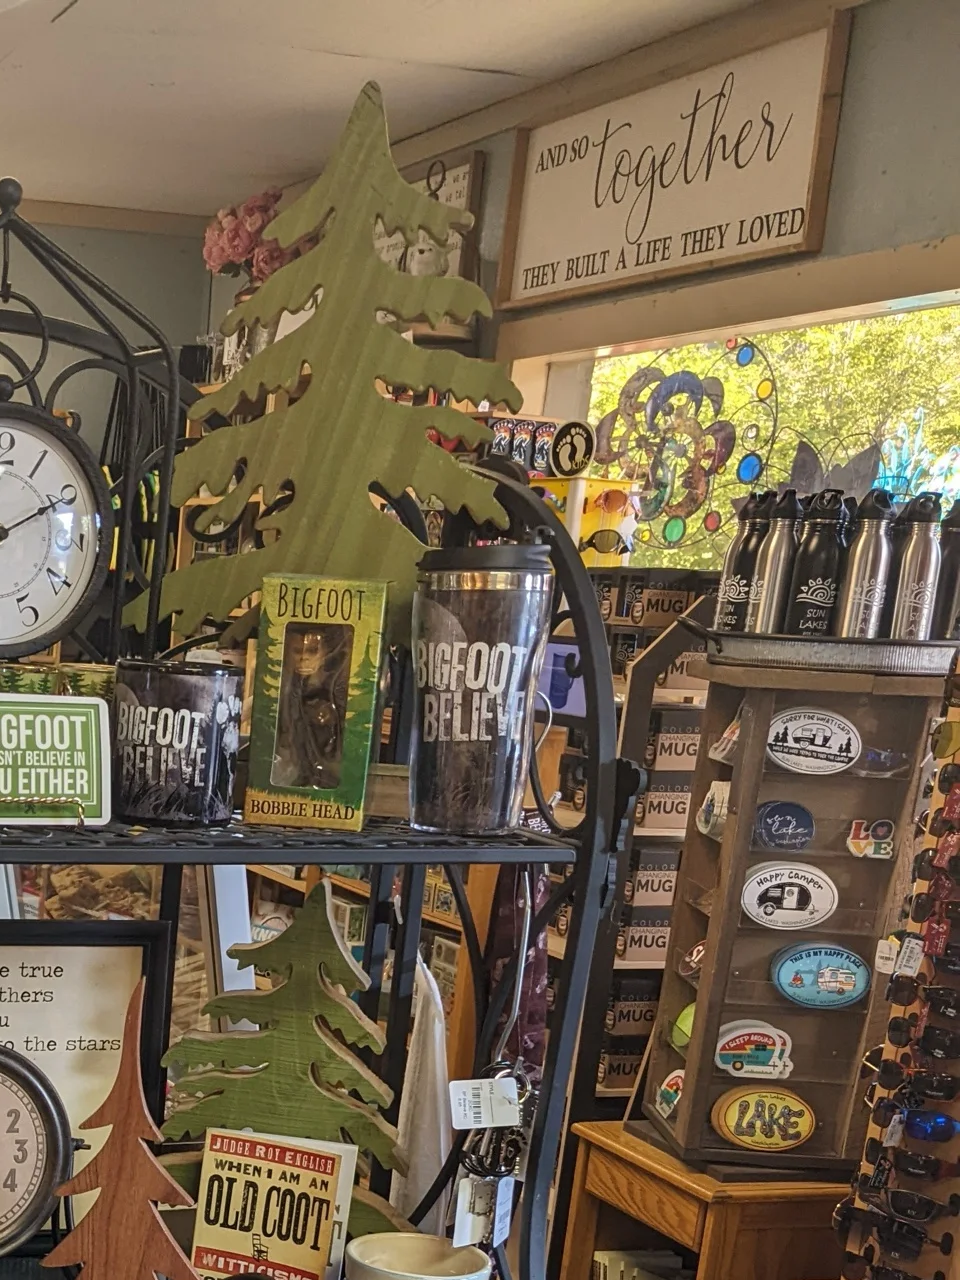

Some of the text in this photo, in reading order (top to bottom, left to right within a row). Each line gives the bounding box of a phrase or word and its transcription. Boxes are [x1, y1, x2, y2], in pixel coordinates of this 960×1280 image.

[534, 135, 589, 173] AND SO
[592, 71, 793, 245] together
[522, 207, 806, 290] THEY BUILT A LIFE THEY LOVED
[573, 455, 589, 470] KIDS
[278, 582, 365, 620] BIGFOOT
[646, 599, 683, 612] MUG
[799, 620, 828, 629] LAKES
[417, 640, 528, 694] BIGFOOT
[117, 702, 208, 750] BIGFOOT
[781, 715, 801, 725] SORRY
[816, 715, 833, 724] WHAT
[837, 723, 851, 735] SAID
[26, 751, 71, 766] BELIEVE
[74, 752, 85, 766] IN
[659, 743, 697, 756] MUG
[18, 769, 89, 795] EITHER
[251, 800, 355, 820] BOBBLE HEAD
[648, 802, 686, 814] MUG
[636, 880, 673, 892] MUG
[756, 871, 823, 890] Happy Camper
[19, 962, 64, 978] true
[790, 954, 803, 964] THIS
[845, 955, 862, 969] PLACE
[24, 1036, 56, 1051] the
[66, 1037, 121, 1051] stars
[734, 1099, 805, 1141] LAKE
[212, 1133, 333, 1172] JUDGE ROY ENGLISH
[214, 1158, 329, 1192] WHEN I AM AN
[204, 1174, 331, 1251] OLD COOT
